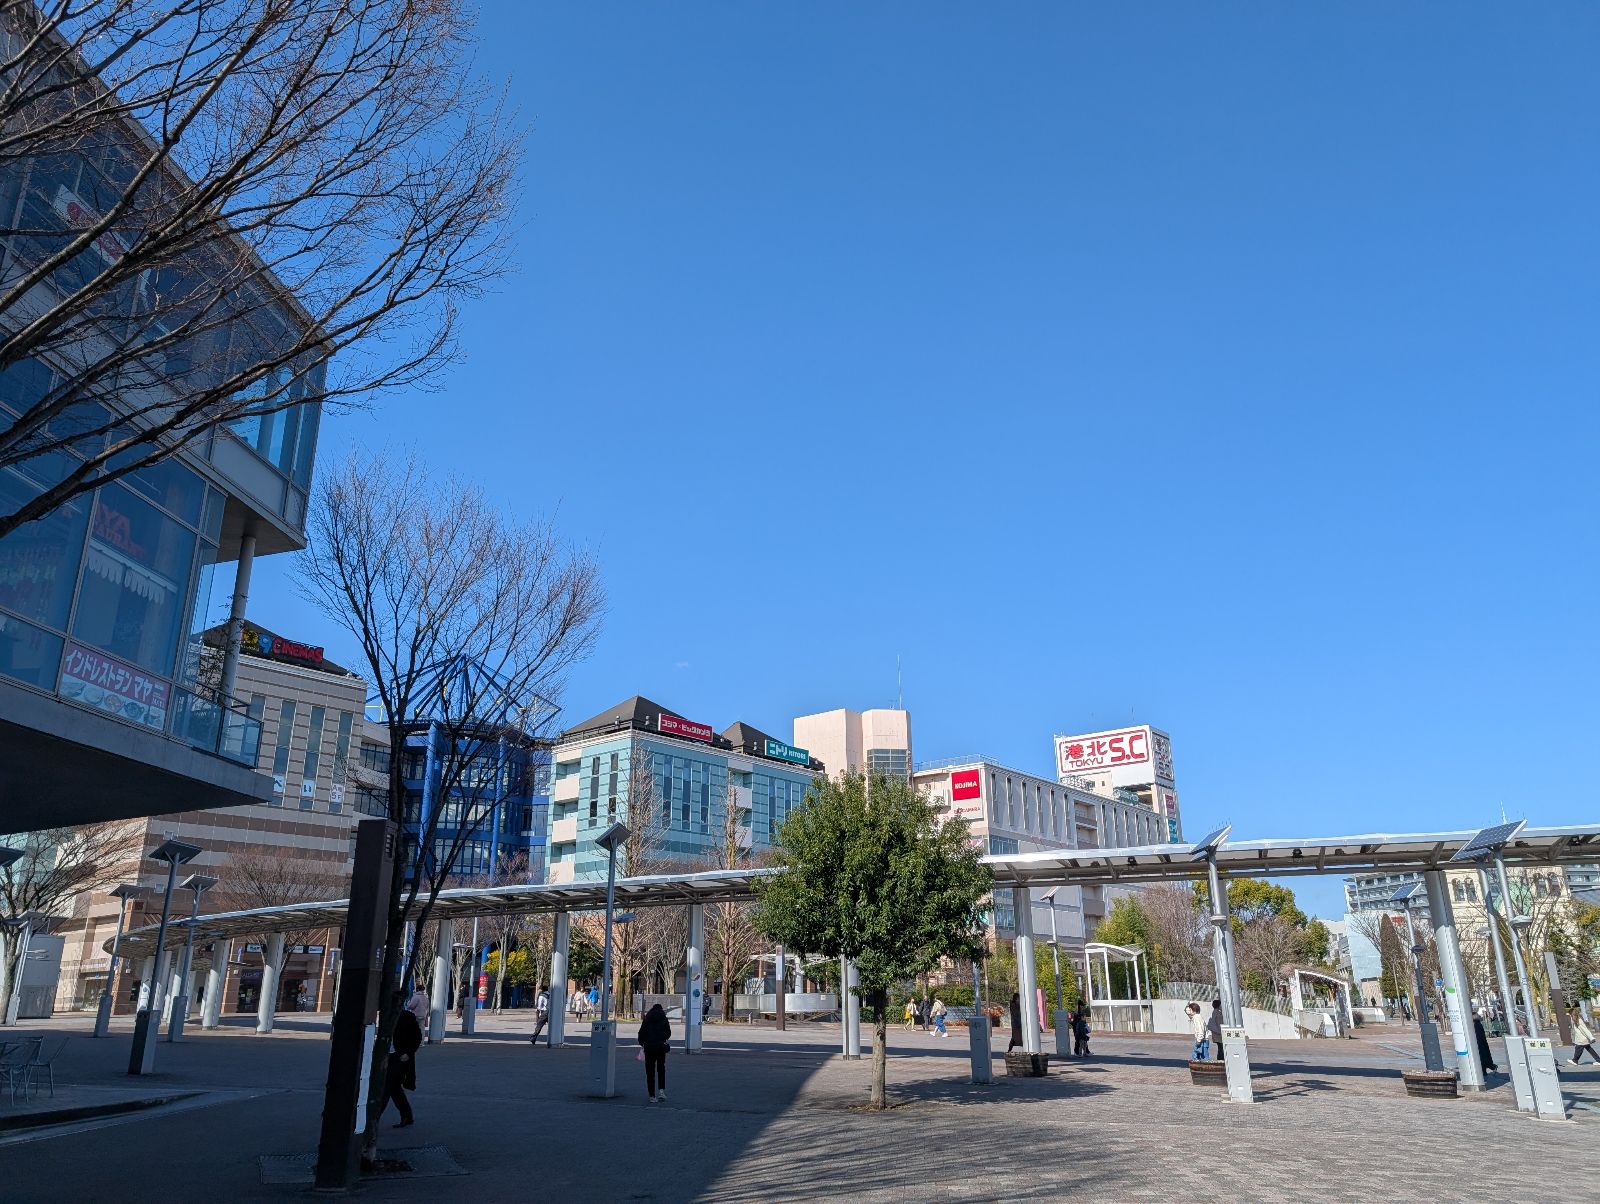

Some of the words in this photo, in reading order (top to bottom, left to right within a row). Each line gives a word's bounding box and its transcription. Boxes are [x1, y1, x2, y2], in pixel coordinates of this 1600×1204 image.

[272, 635, 323, 663] CINEMAS
[65, 649, 132, 693] インドレストラン
[770, 742, 788, 755] ニトリ
[1064, 741, 1108, 760] 港北
[1109, 734, 1146, 762] S.C
[1069, 757, 1104, 768] TOKYU
